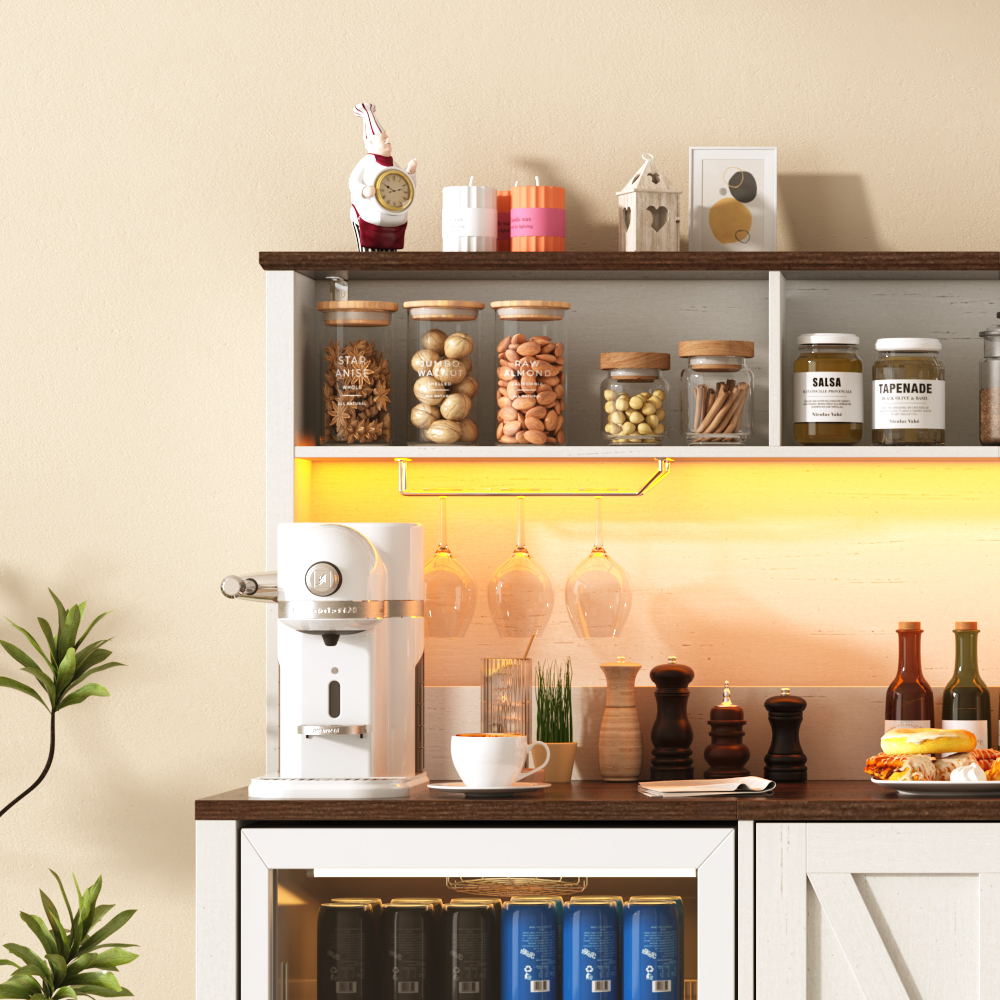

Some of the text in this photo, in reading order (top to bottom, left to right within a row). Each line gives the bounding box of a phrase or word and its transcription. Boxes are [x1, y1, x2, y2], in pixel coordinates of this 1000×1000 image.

[338, 356, 367, 365] STAR
[420, 360, 460, 368] JUMBO
[335, 369, 370, 377] ANISE
[812, 377, 842, 388] SALSA
[878, 383, 933, 394] TAPENADE
